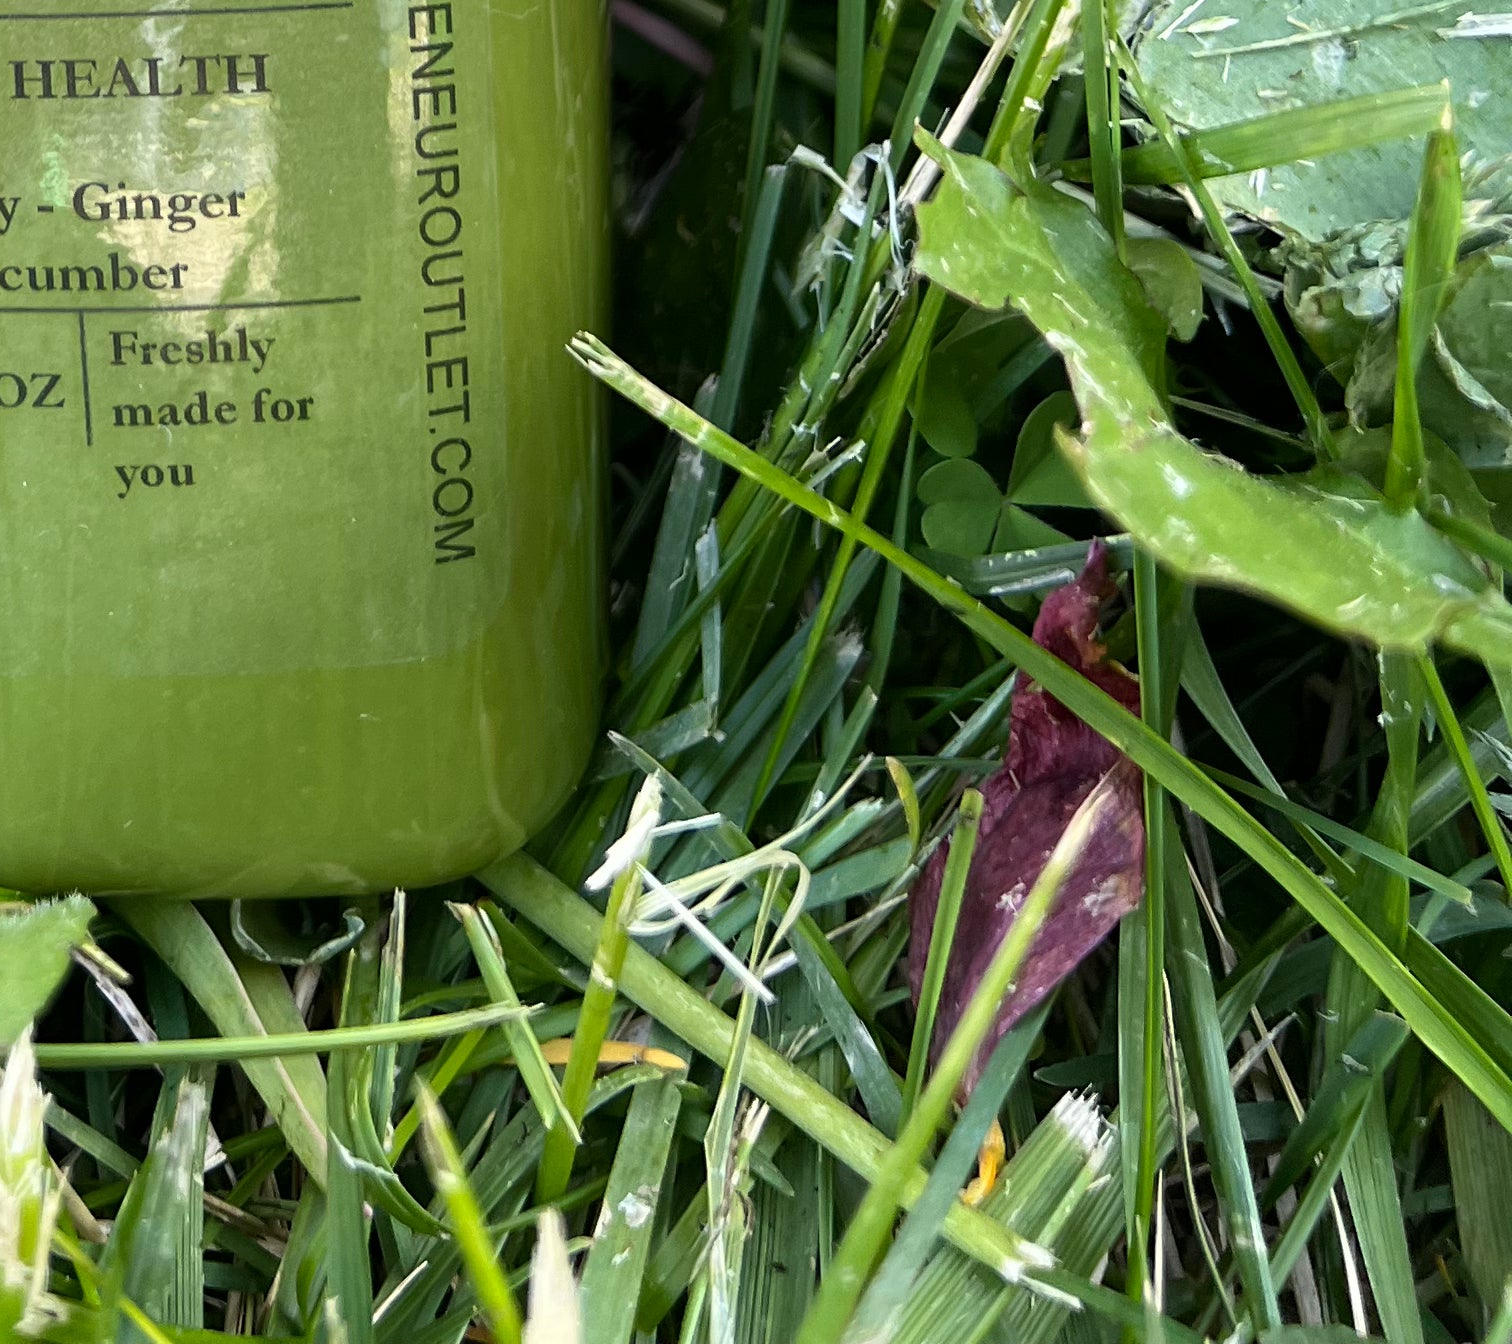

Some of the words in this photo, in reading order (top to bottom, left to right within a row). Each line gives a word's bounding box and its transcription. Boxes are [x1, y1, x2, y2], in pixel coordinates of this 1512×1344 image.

[10, 53, 271, 99] HEALTH
[72, 182, 246, 233] Ginger
[110, 327, 276, 373] Freshly
[112, 390, 237, 427] made
[254, 389, 315, 423] for
[115, 457, 196, 498] you
